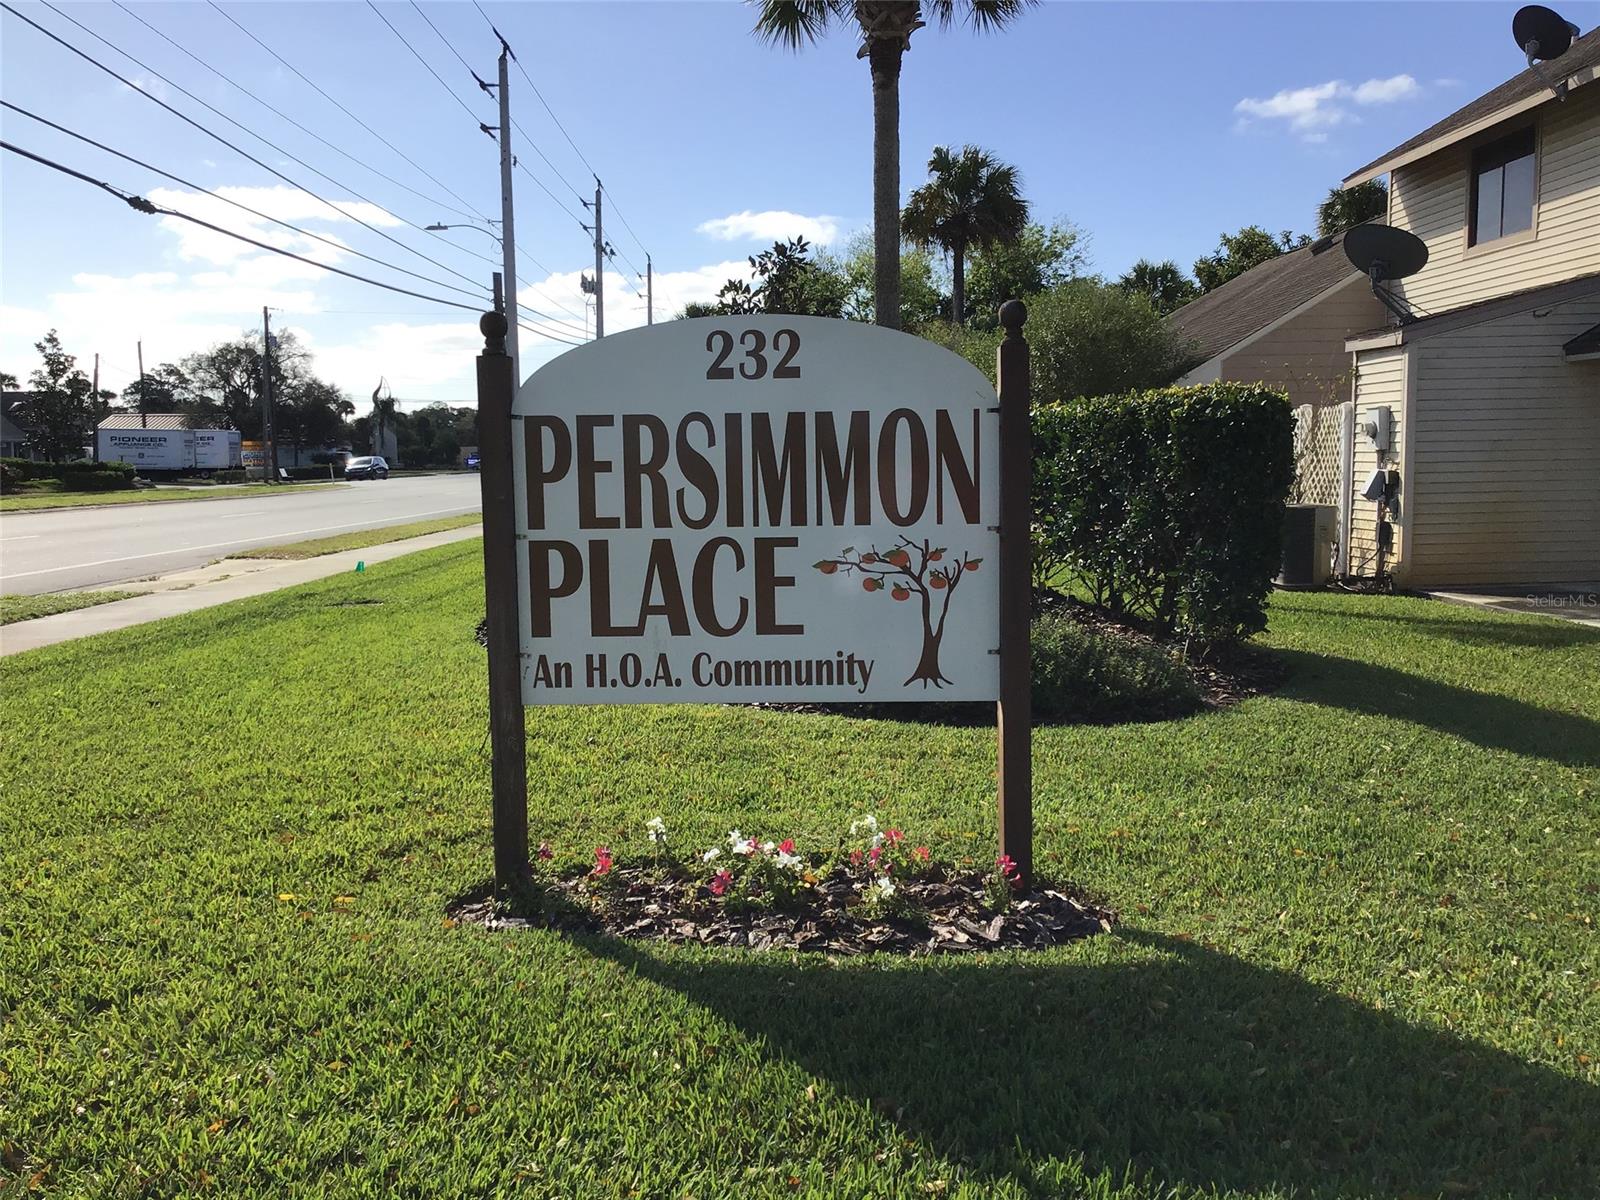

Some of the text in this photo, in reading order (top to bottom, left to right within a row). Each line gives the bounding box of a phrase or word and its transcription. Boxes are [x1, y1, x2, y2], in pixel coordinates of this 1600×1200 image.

[706, 329, 801, 380] 232
[524, 408, 981, 530] PERSIMMON
[528, 536, 804, 638] PLACE
[533, 651, 874, 694] An H.O.A. Community
